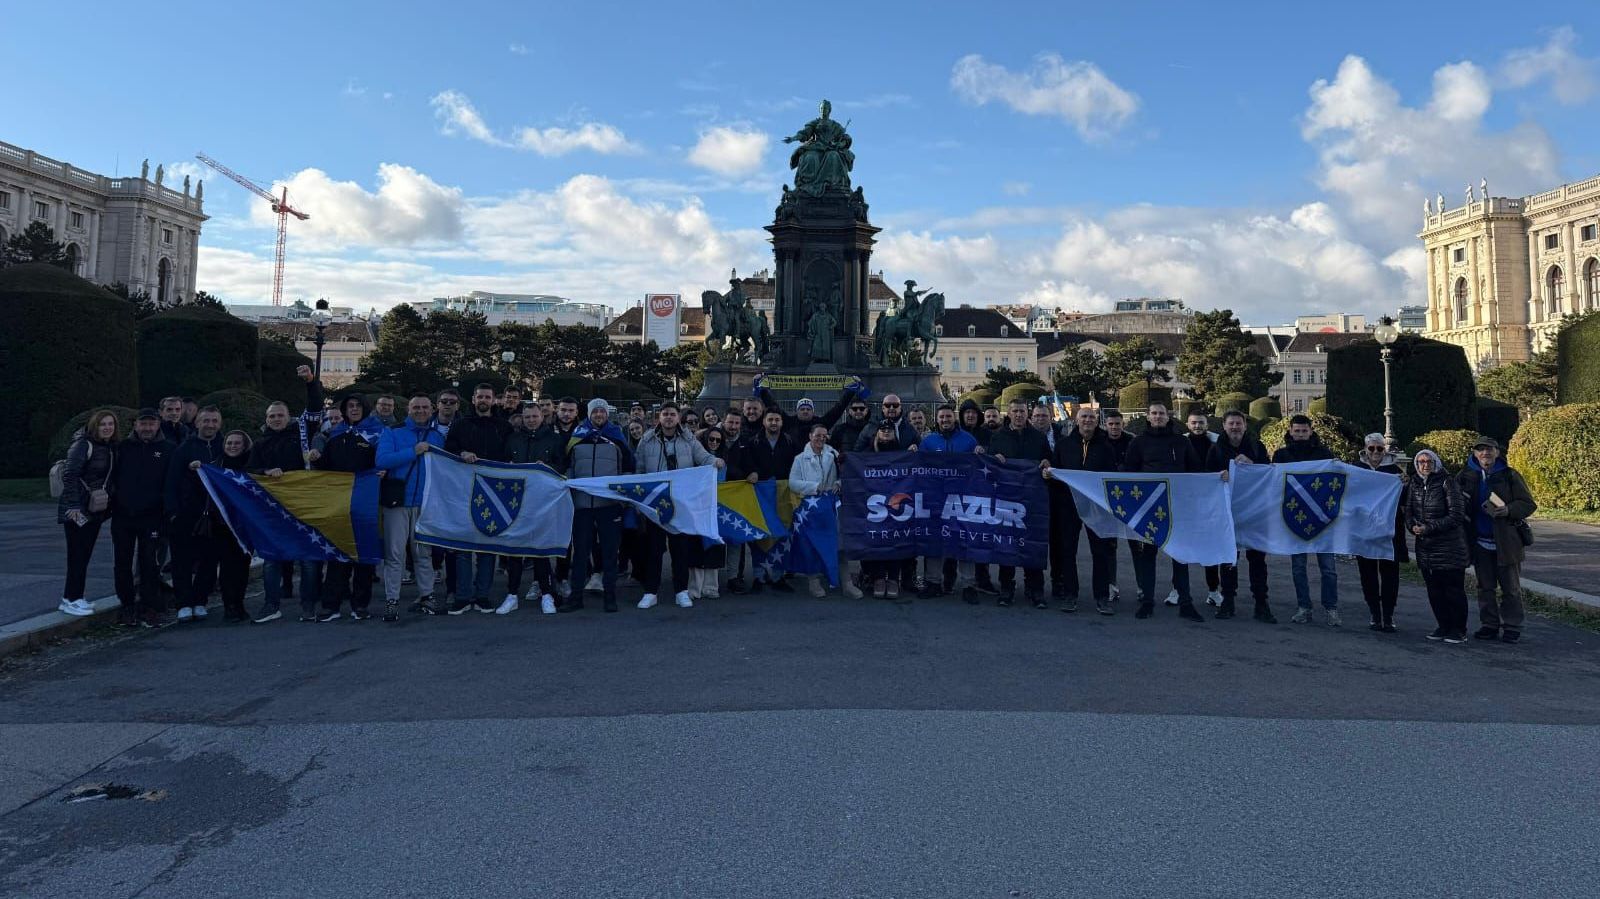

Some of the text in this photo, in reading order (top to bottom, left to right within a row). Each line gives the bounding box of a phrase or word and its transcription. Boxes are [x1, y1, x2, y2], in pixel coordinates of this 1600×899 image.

[864, 468, 898, 478] UŽIVAJ
[901, 468, 909, 476] U
[866, 492, 1027, 530] SOL AZUR
[868, 525, 1026, 547] TRAVEL & EVENTS
